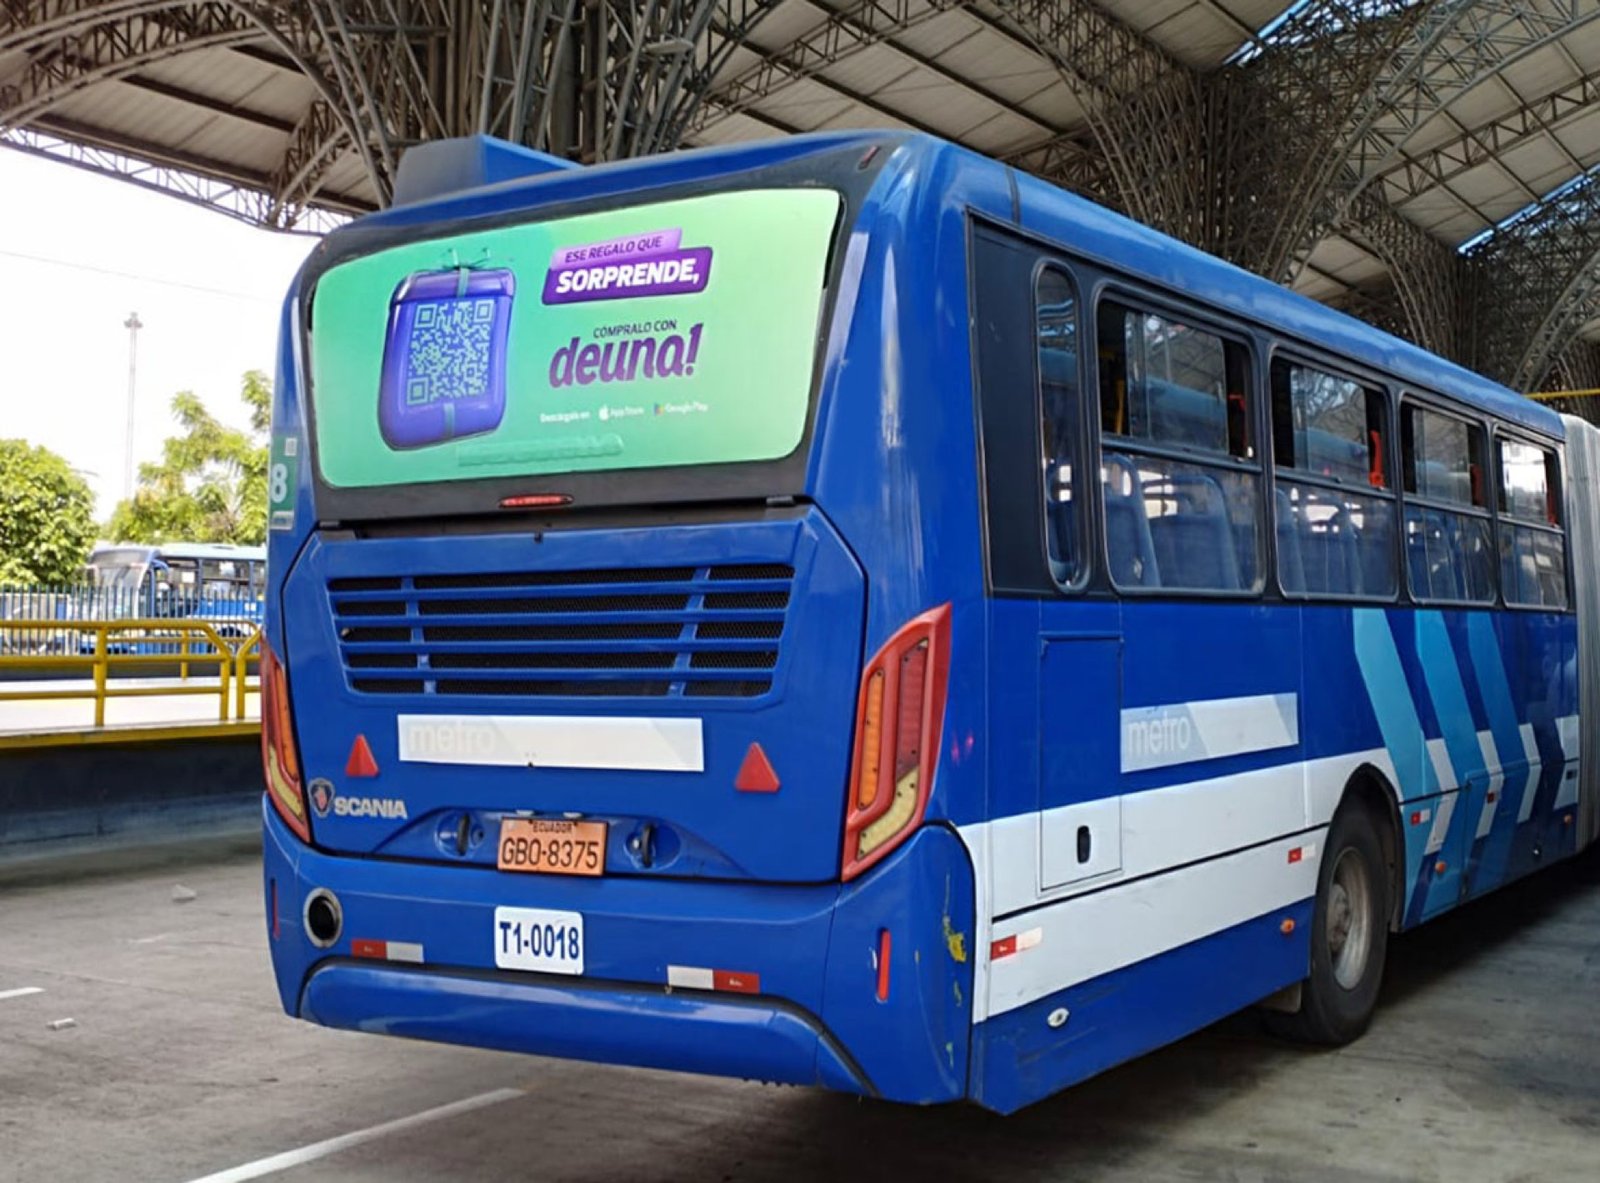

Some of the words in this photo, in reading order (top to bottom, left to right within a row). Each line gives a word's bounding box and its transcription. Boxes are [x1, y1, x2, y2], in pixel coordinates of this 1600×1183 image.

[565, 248, 587, 263] ESE
[588, 240, 635, 259] REGALO
[637, 236, 662, 251] QUE
[555, 258, 700, 293] SORPRENDE,
[653, 319, 677, 332] CON
[549, 323, 704, 388] deuna!
[408, 719, 496, 754] metro
[1128, 710, 1191, 755] metro
[334, 796, 408, 818] SCANIA
[533, 821, 573, 832] ECUADOR
[502, 837, 600, 869] GBO-8375
[499, 920, 580, 960] T1-0018
